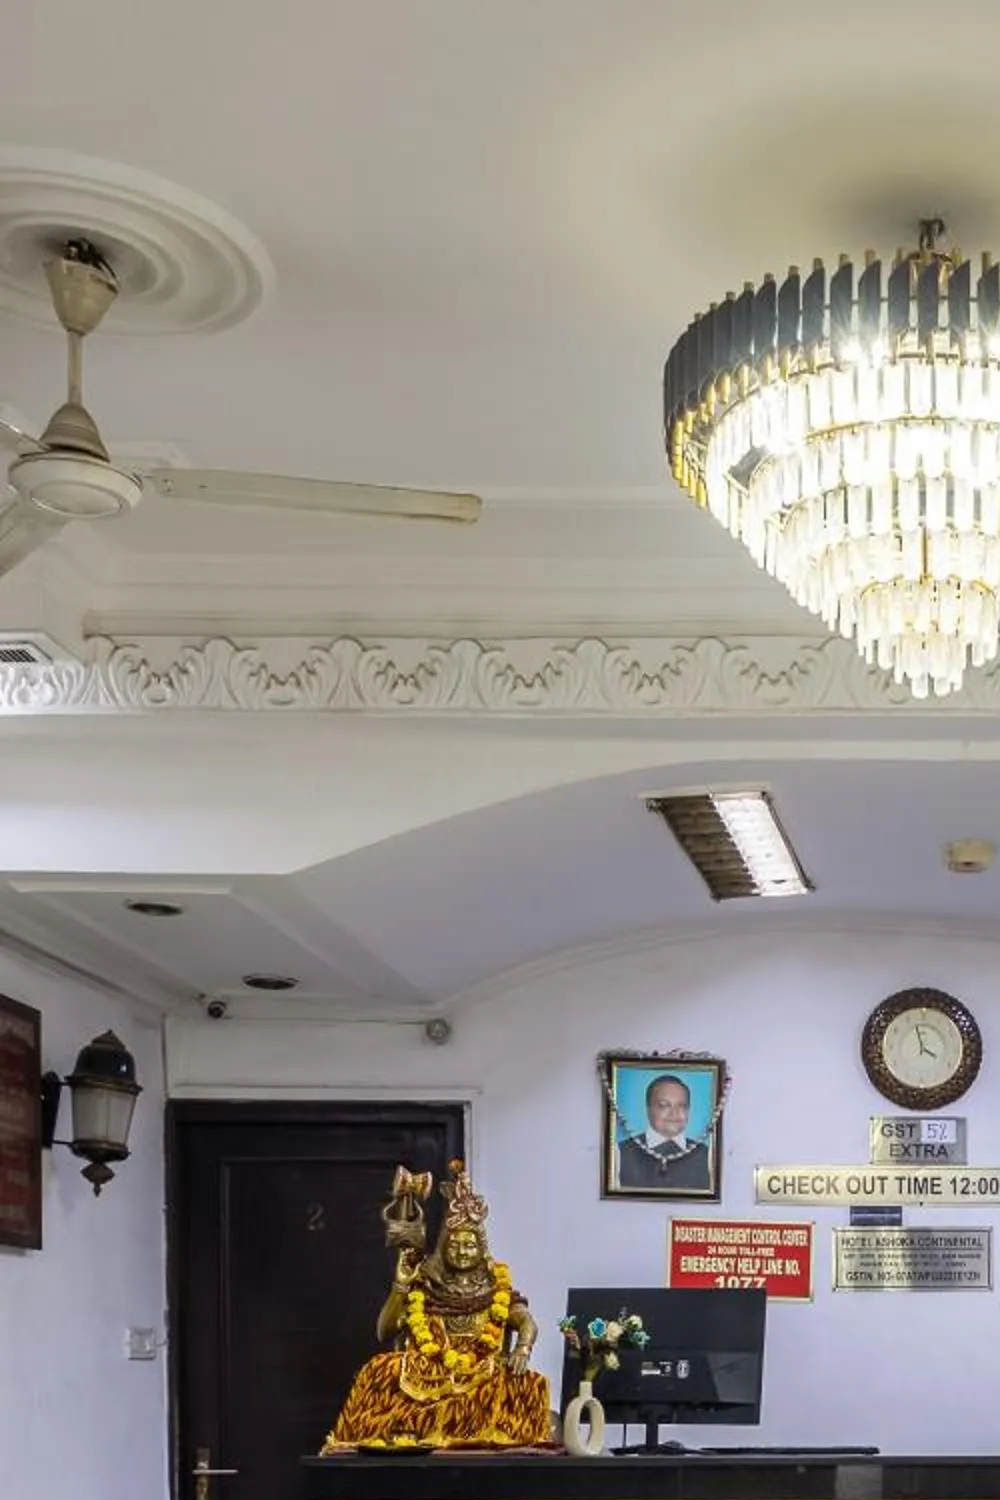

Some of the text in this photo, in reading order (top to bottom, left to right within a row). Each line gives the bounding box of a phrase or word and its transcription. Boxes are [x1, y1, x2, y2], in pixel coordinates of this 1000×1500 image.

[880, 1122, 949, 1141] GST 5%
[888, 1143, 950, 1159] EXTRA
[767, 1175, 840, 1195] CHECK
[846, 1175, 889, 1195] OUT
[895, 1175, 942, 1195] TIME
[949, 1175, 999, 1195] 12:00
[306, 1203, 325, 1231] 2
[707, 1245, 717, 1255] 24
[718, 1246, 737, 1256] HOUR
[841, 1236, 983, 1249] HOTEL ASHOKA CONTINENTAL
[681, 1256, 801, 1276] EMERGENCY HELP LINE NO.
